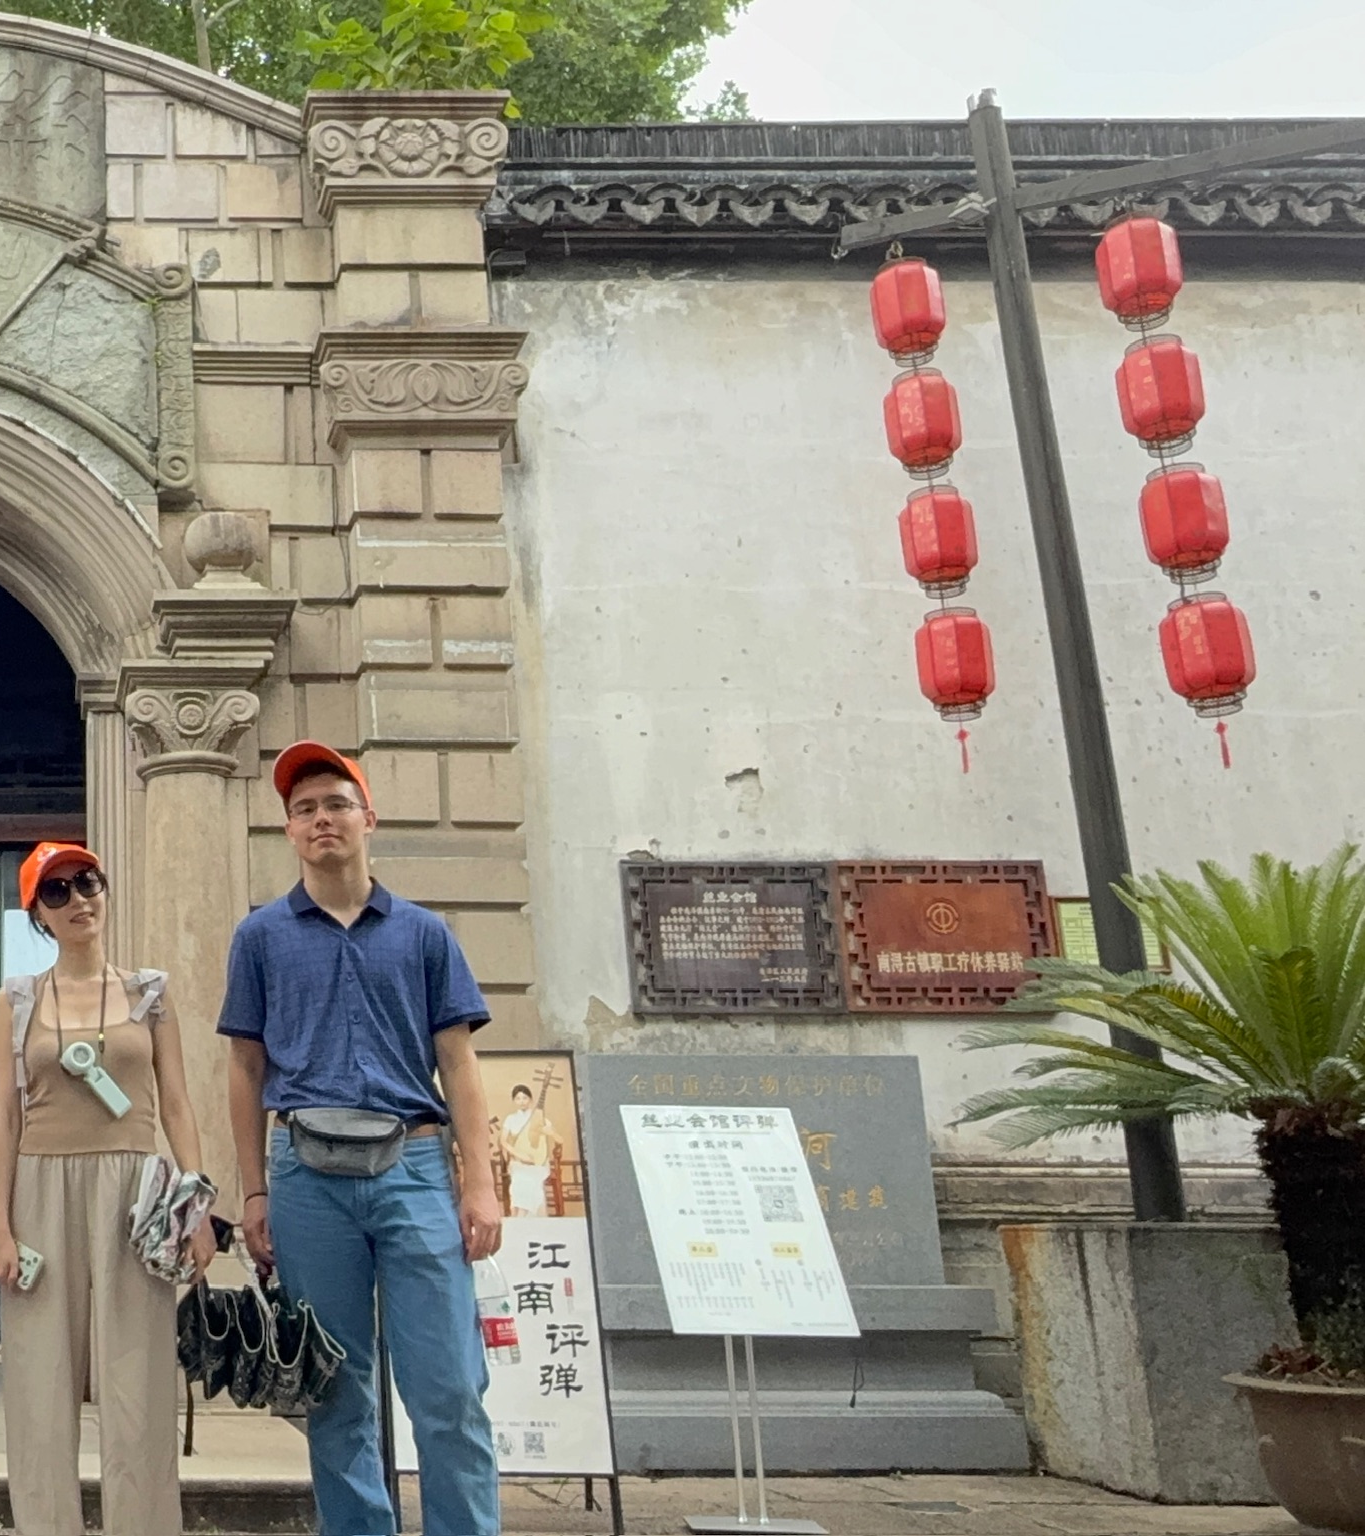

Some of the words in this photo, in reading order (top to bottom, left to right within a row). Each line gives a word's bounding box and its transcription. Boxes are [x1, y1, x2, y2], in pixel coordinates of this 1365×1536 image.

[876, 951, 1025, 974] 南浔古镇职工疗休养驿站
[626, 1073, 885, 1097] 全国重点文物保护单位
[640, 1112, 779, 1130] 丝业会馆评弹
[513, 1241, 591, 1399] 江南评弹
